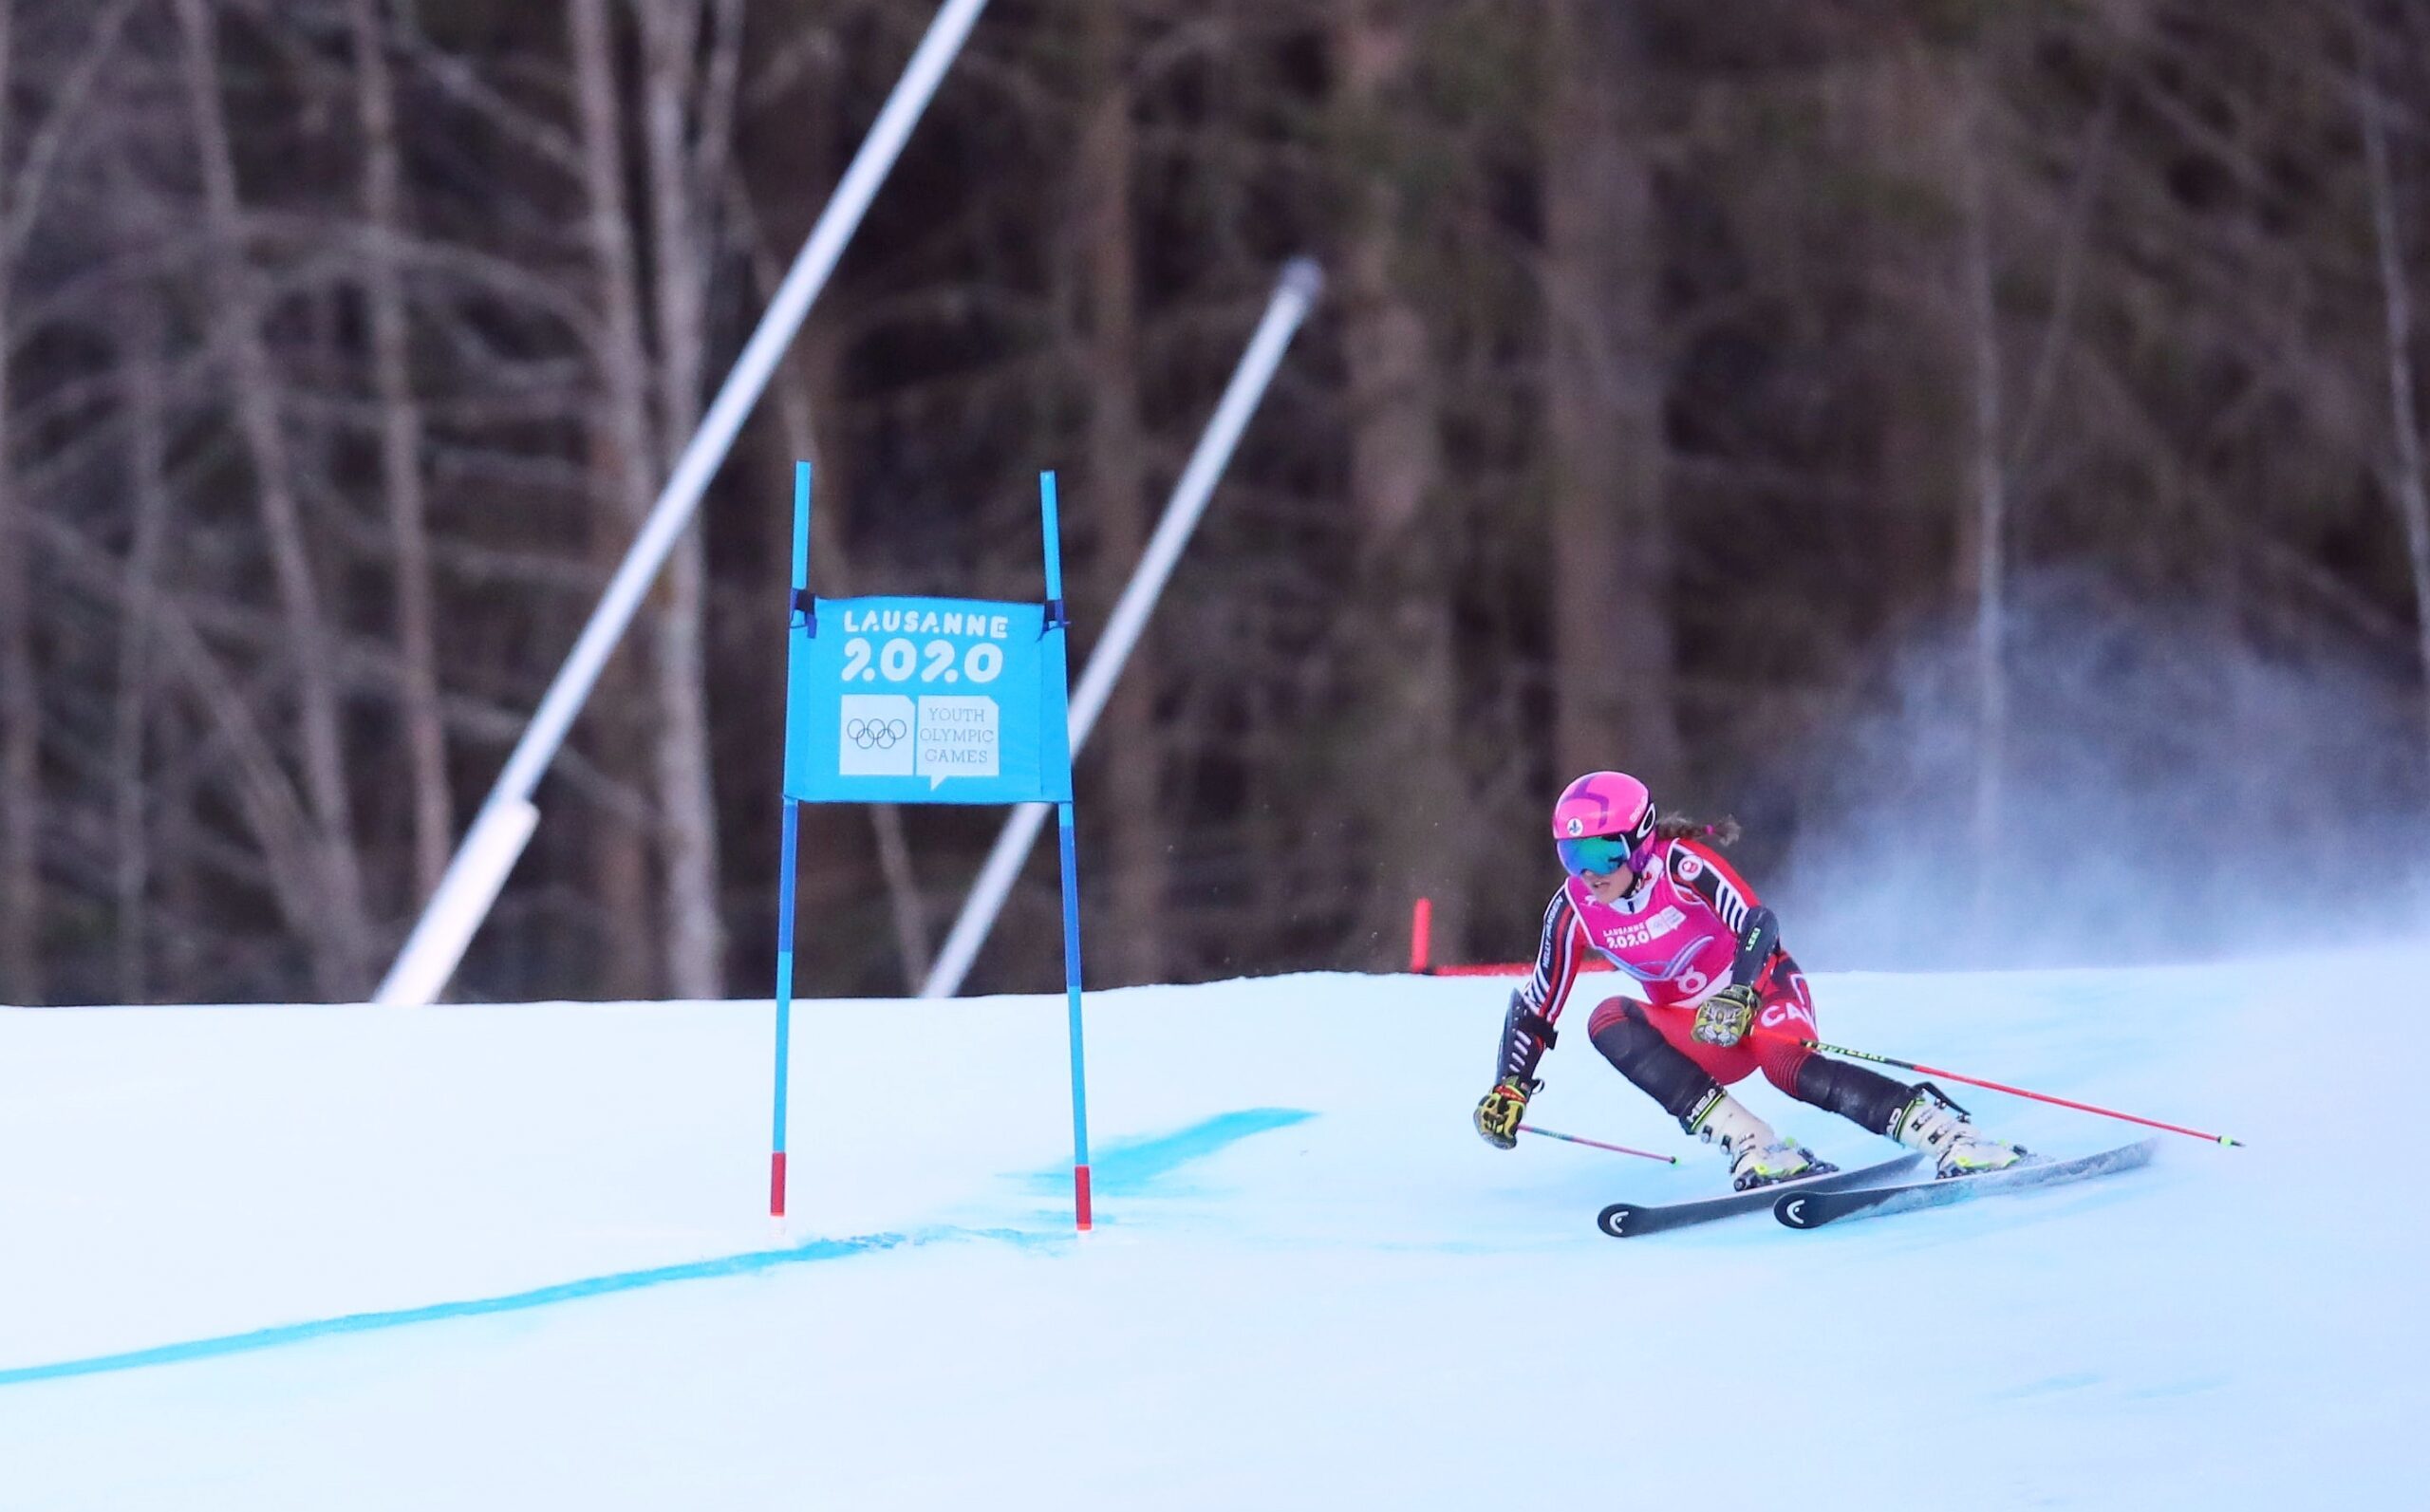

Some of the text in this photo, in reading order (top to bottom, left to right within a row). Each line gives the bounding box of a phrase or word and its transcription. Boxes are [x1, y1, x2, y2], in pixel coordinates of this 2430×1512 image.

[843, 610, 1008, 638] LAUSANNE
[928, 708, 984, 722] YOUTH
[920, 728, 994, 742] OLYMPIC
[925, 749, 987, 764] GAMES
